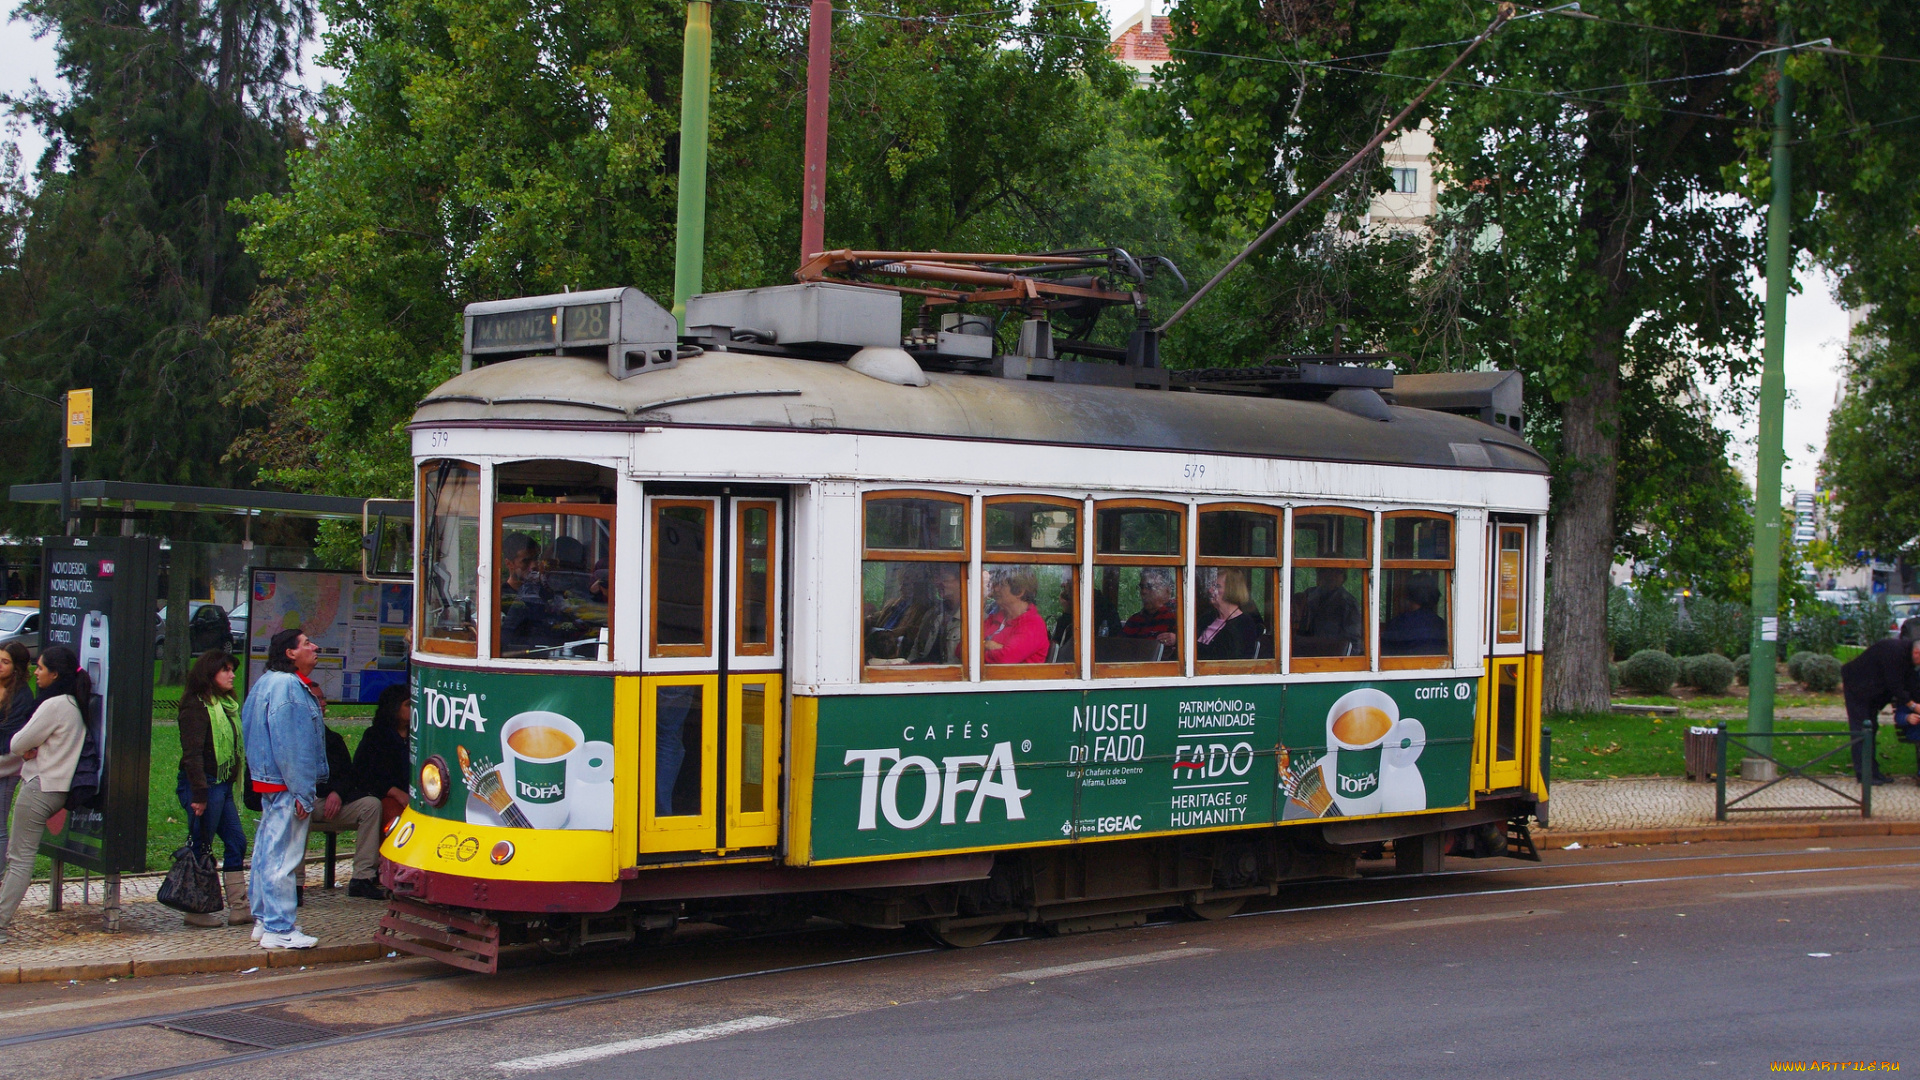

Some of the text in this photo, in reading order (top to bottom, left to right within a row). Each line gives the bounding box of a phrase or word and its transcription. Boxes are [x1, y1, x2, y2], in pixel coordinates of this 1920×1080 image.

[575, 307, 603, 337] 28
[432, 432, 449, 447] 579
[1184, 464, 1206, 478] 579
[52, 562, 67, 574] NOVO
[51, 579, 68, 591] NOVAS
[50, 596, 57, 608] DE
[50, 611, 77, 626] SÓ MESMO
[50, 630, 55, 641] O
[437, 680, 467, 691] CAFÉS
[1415, 682, 1449, 700] carris
[424, 687, 488, 733] TOFA
[1179, 698, 1255, 713] PATRIMÓNIO DA
[1073, 704, 1147, 732] MUSEU
[1178, 713, 1255, 729] HUMANIDADE
[903, 721, 988, 741] CAFÉS
[1070, 734, 1144, 763] DO FADO
[1172, 742, 1254, 779] FADO
[1085, 768, 1111, 776] Chafariz
[1112, 767, 1120, 775] de
[1121, 766, 1143, 774] Dentro
[517, 780, 563, 798] TOFA
[844, 741, 1032, 831] TOFA
[1082, 777, 1126, 787] Alfama, Lisboa
[1338, 773, 1377, 792] TOFA
[1172, 792, 1247, 809] HERITAGE OF
[1098, 815, 1142, 833] EGEAC
[1171, 807, 1246, 827] HUMANITY
